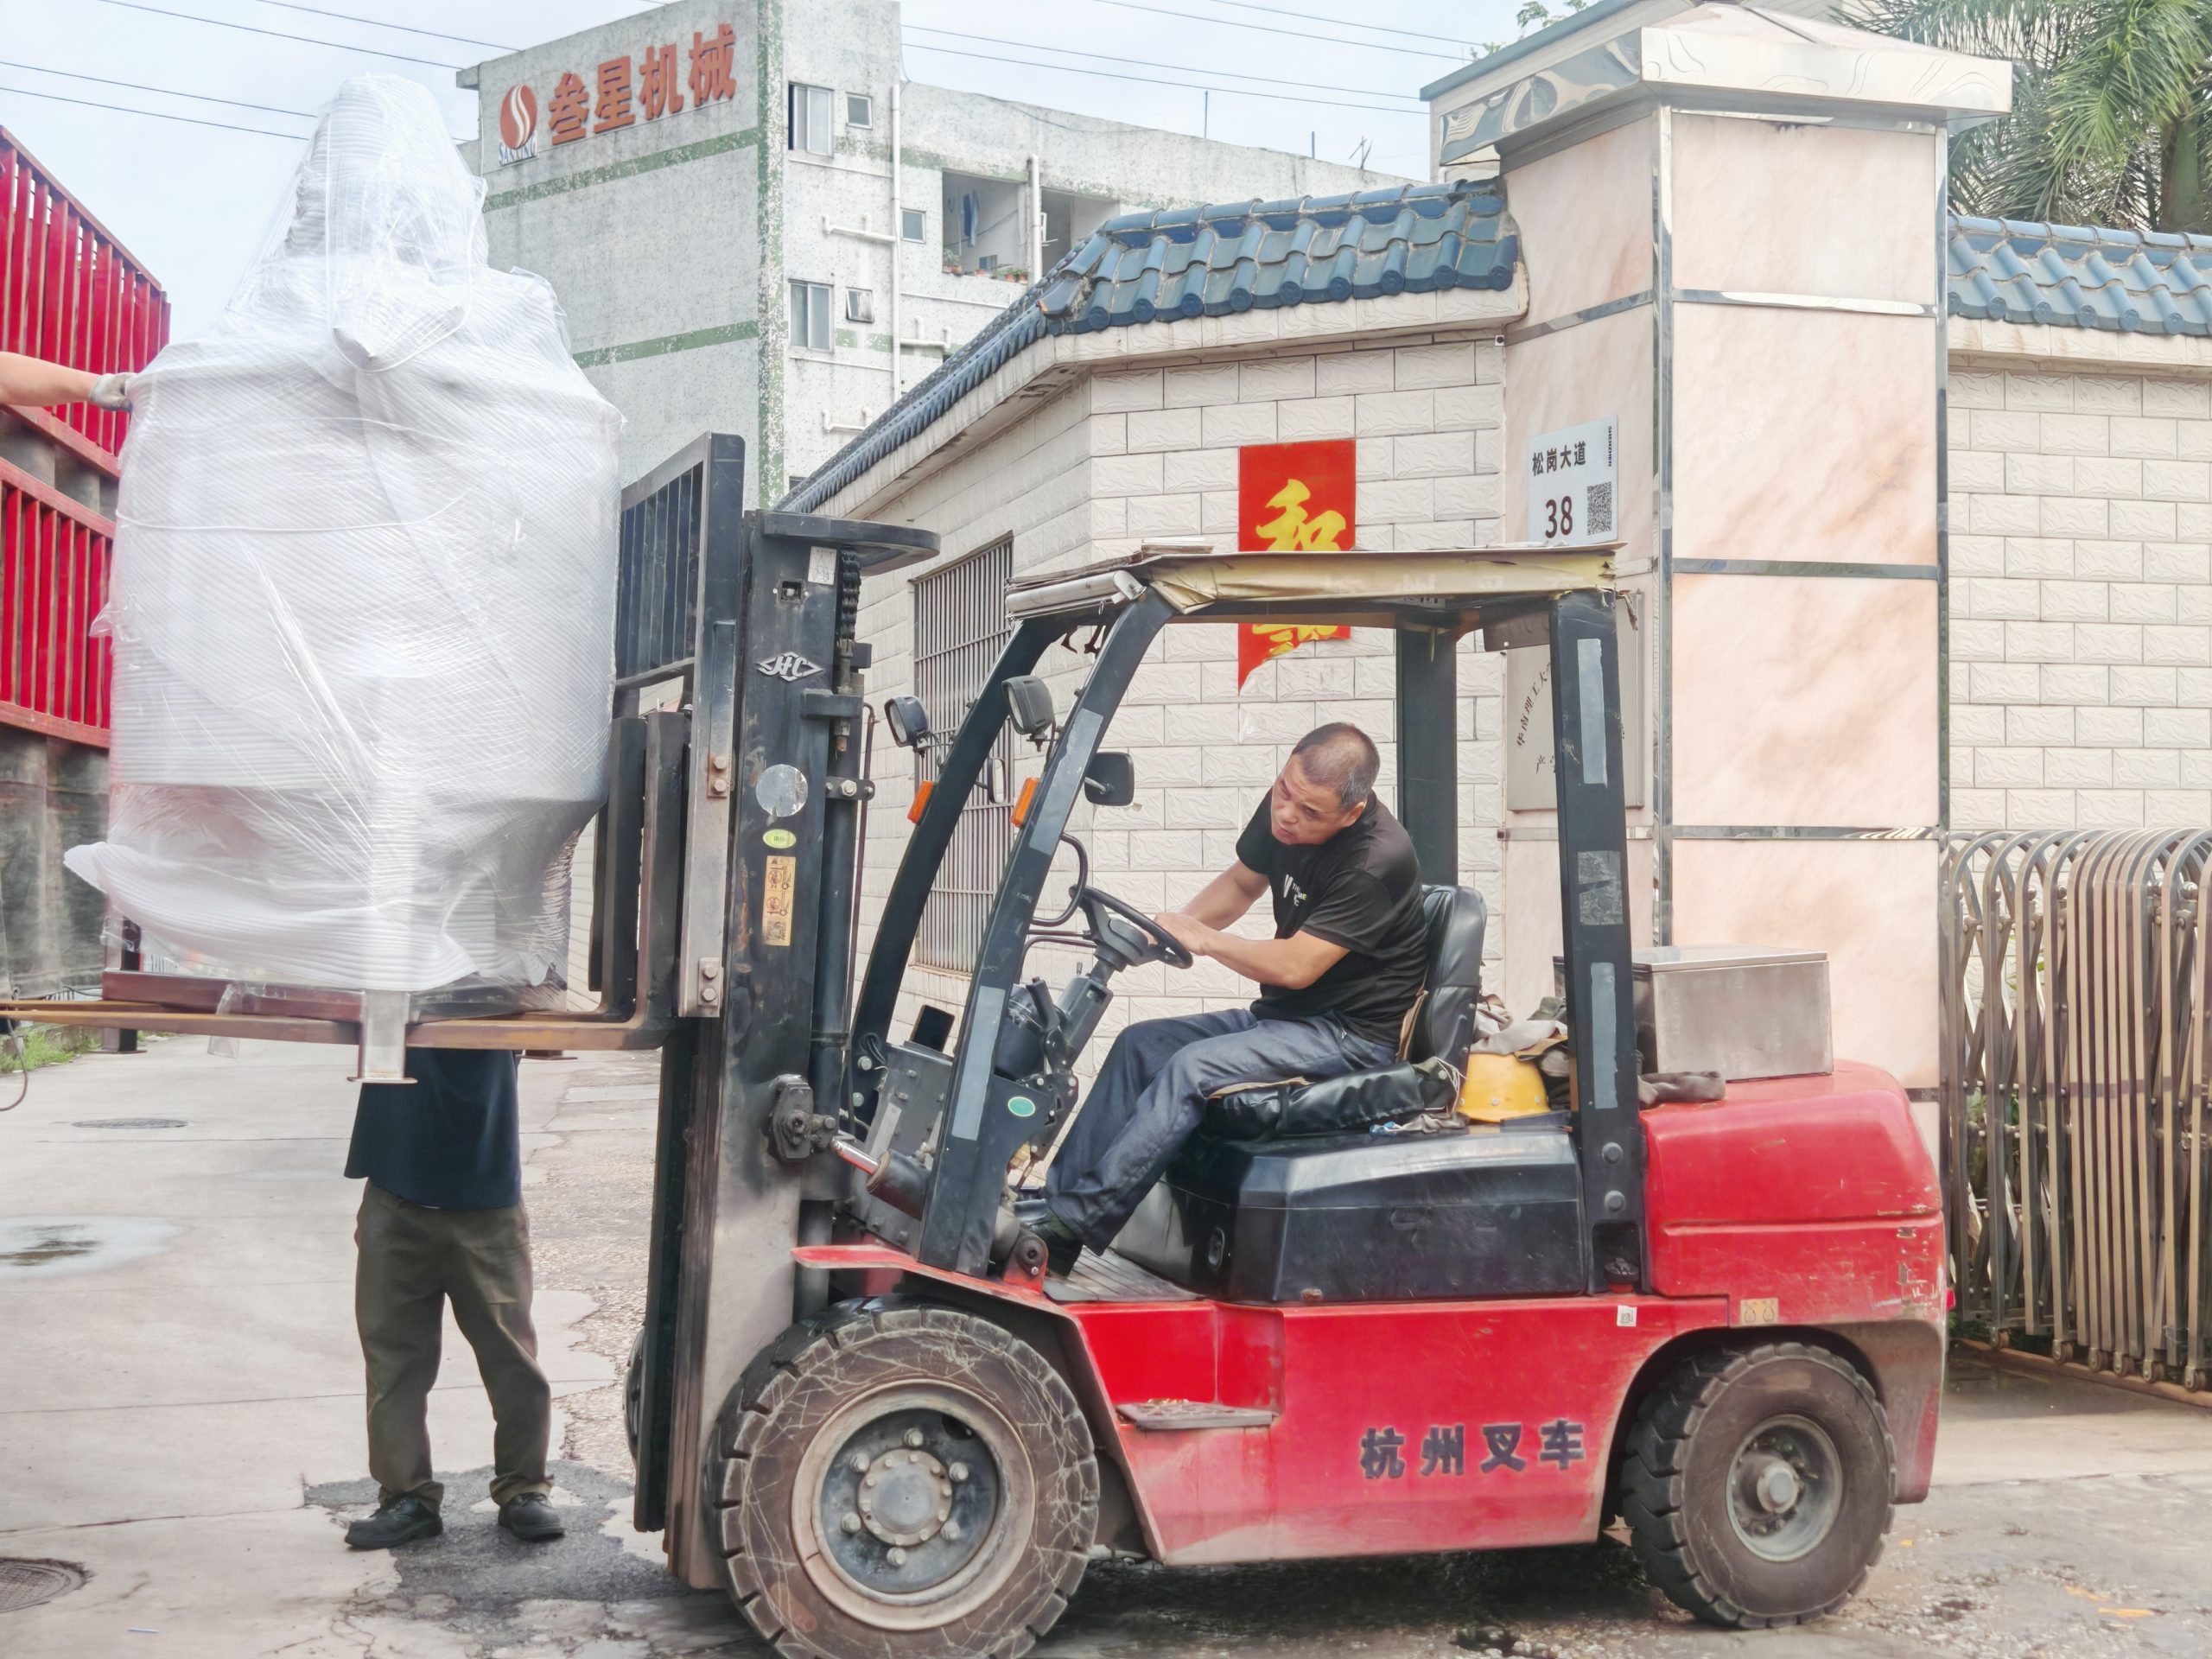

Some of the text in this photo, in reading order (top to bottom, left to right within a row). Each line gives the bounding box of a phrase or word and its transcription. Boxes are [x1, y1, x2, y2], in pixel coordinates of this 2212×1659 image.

[548, 23, 737, 146] 叁星机械
[1532, 441, 1586, 476] 松岗大道
[1545, 495, 1573, 539] 38
[1516, 662, 1552, 747] 华南理工大
[1360, 1417, 1586, 1479] 杭州叉车
